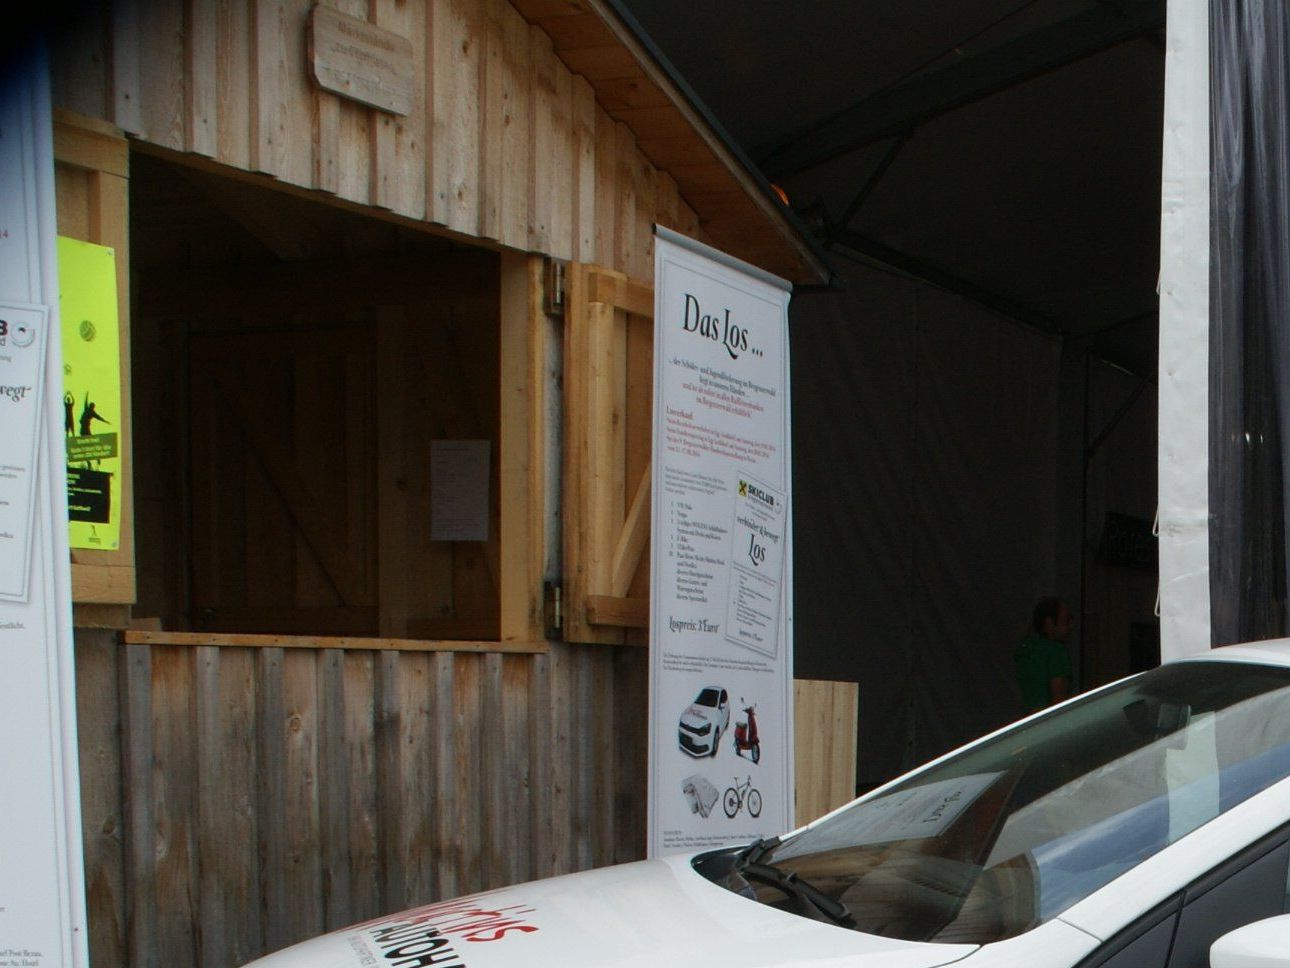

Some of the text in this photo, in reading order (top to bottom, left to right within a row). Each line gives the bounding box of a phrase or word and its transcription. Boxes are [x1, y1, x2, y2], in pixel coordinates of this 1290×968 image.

[683, 293, 719, 341] Das
[722, 308, 748, 360] Los
[748, 484, 775, 506] SKICLUB
[748, 533, 766, 566] Los
